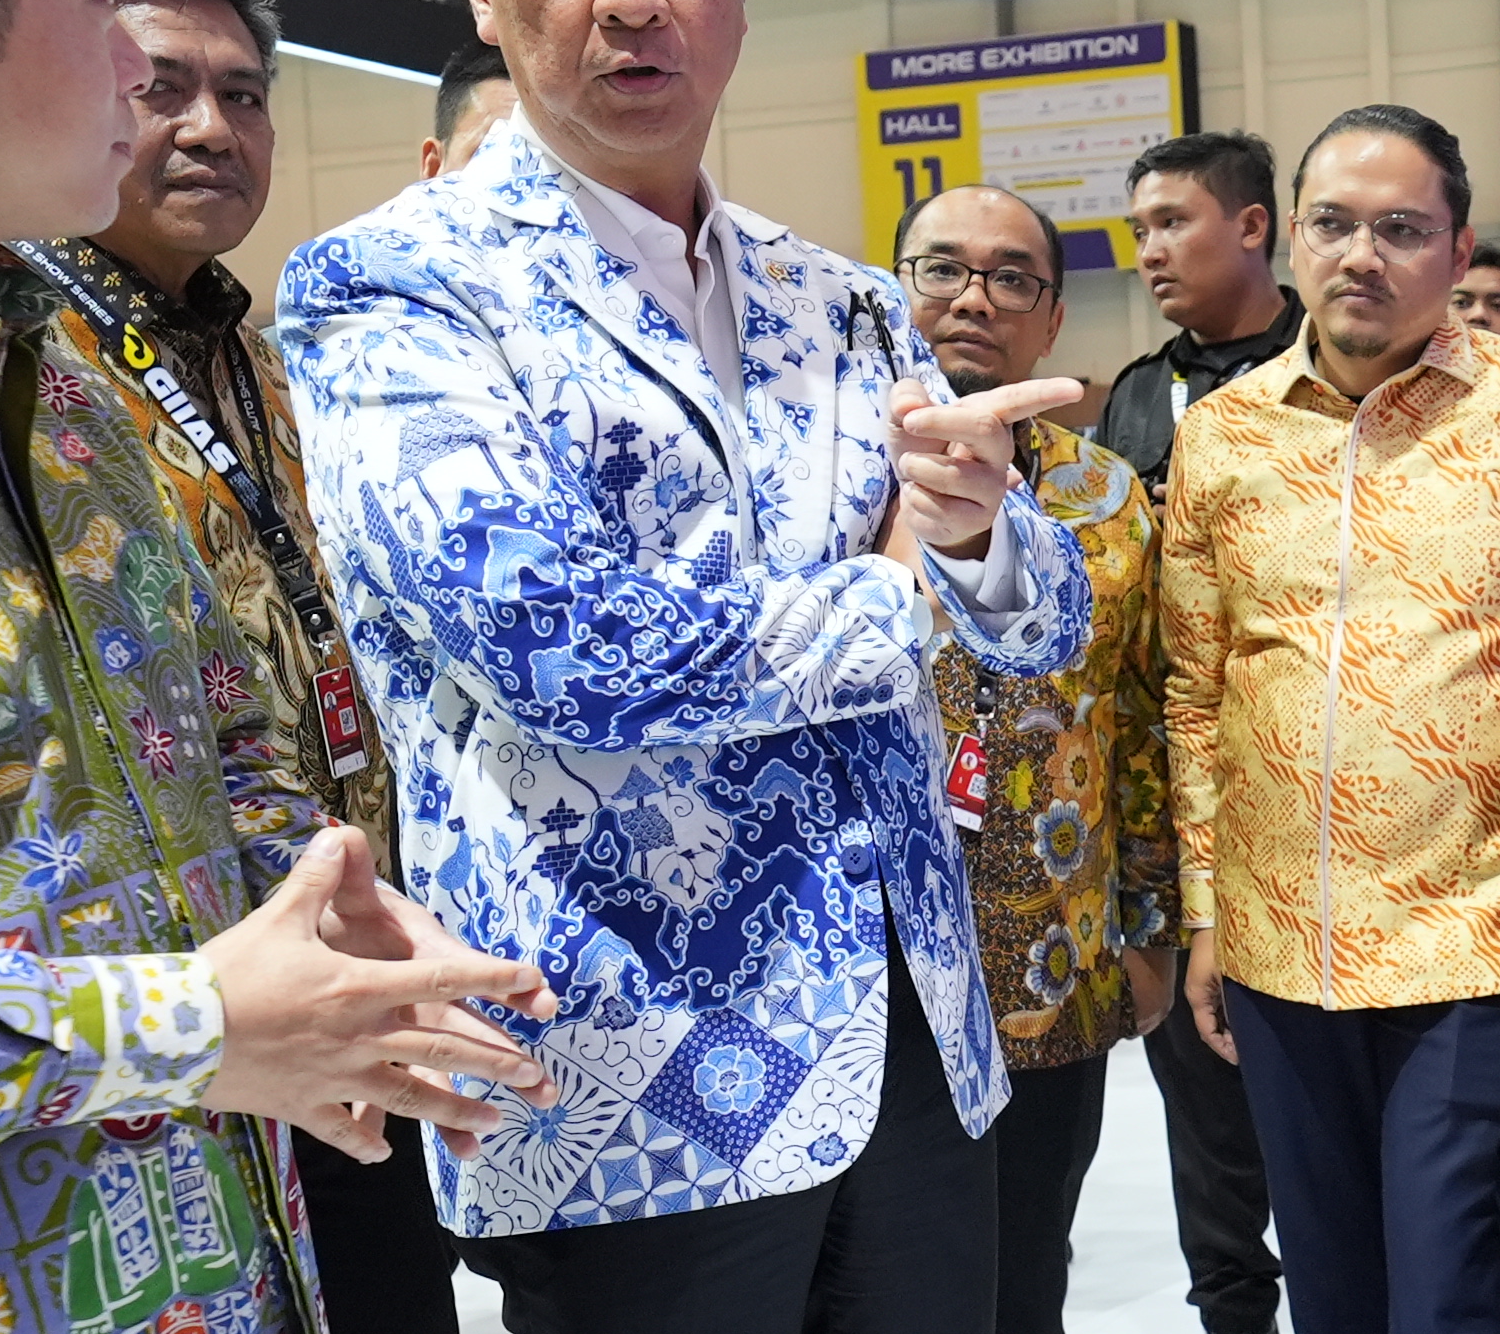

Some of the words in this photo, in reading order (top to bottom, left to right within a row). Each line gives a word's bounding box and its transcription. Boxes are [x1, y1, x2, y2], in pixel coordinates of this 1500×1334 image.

[891, 50, 974, 79] MORE
[980, 34, 1139, 68] EXHIBITION
[884, 111, 957, 137] HALL
[16, 240, 35, 255] TO
[32, 251, 74, 285] SHOW
[70, 284, 116, 327] SERIES
[143, 366, 239, 474] GIIAS
[243, 401, 262, 432] AUTO
[1170, 382, 1189, 424] GIIA
